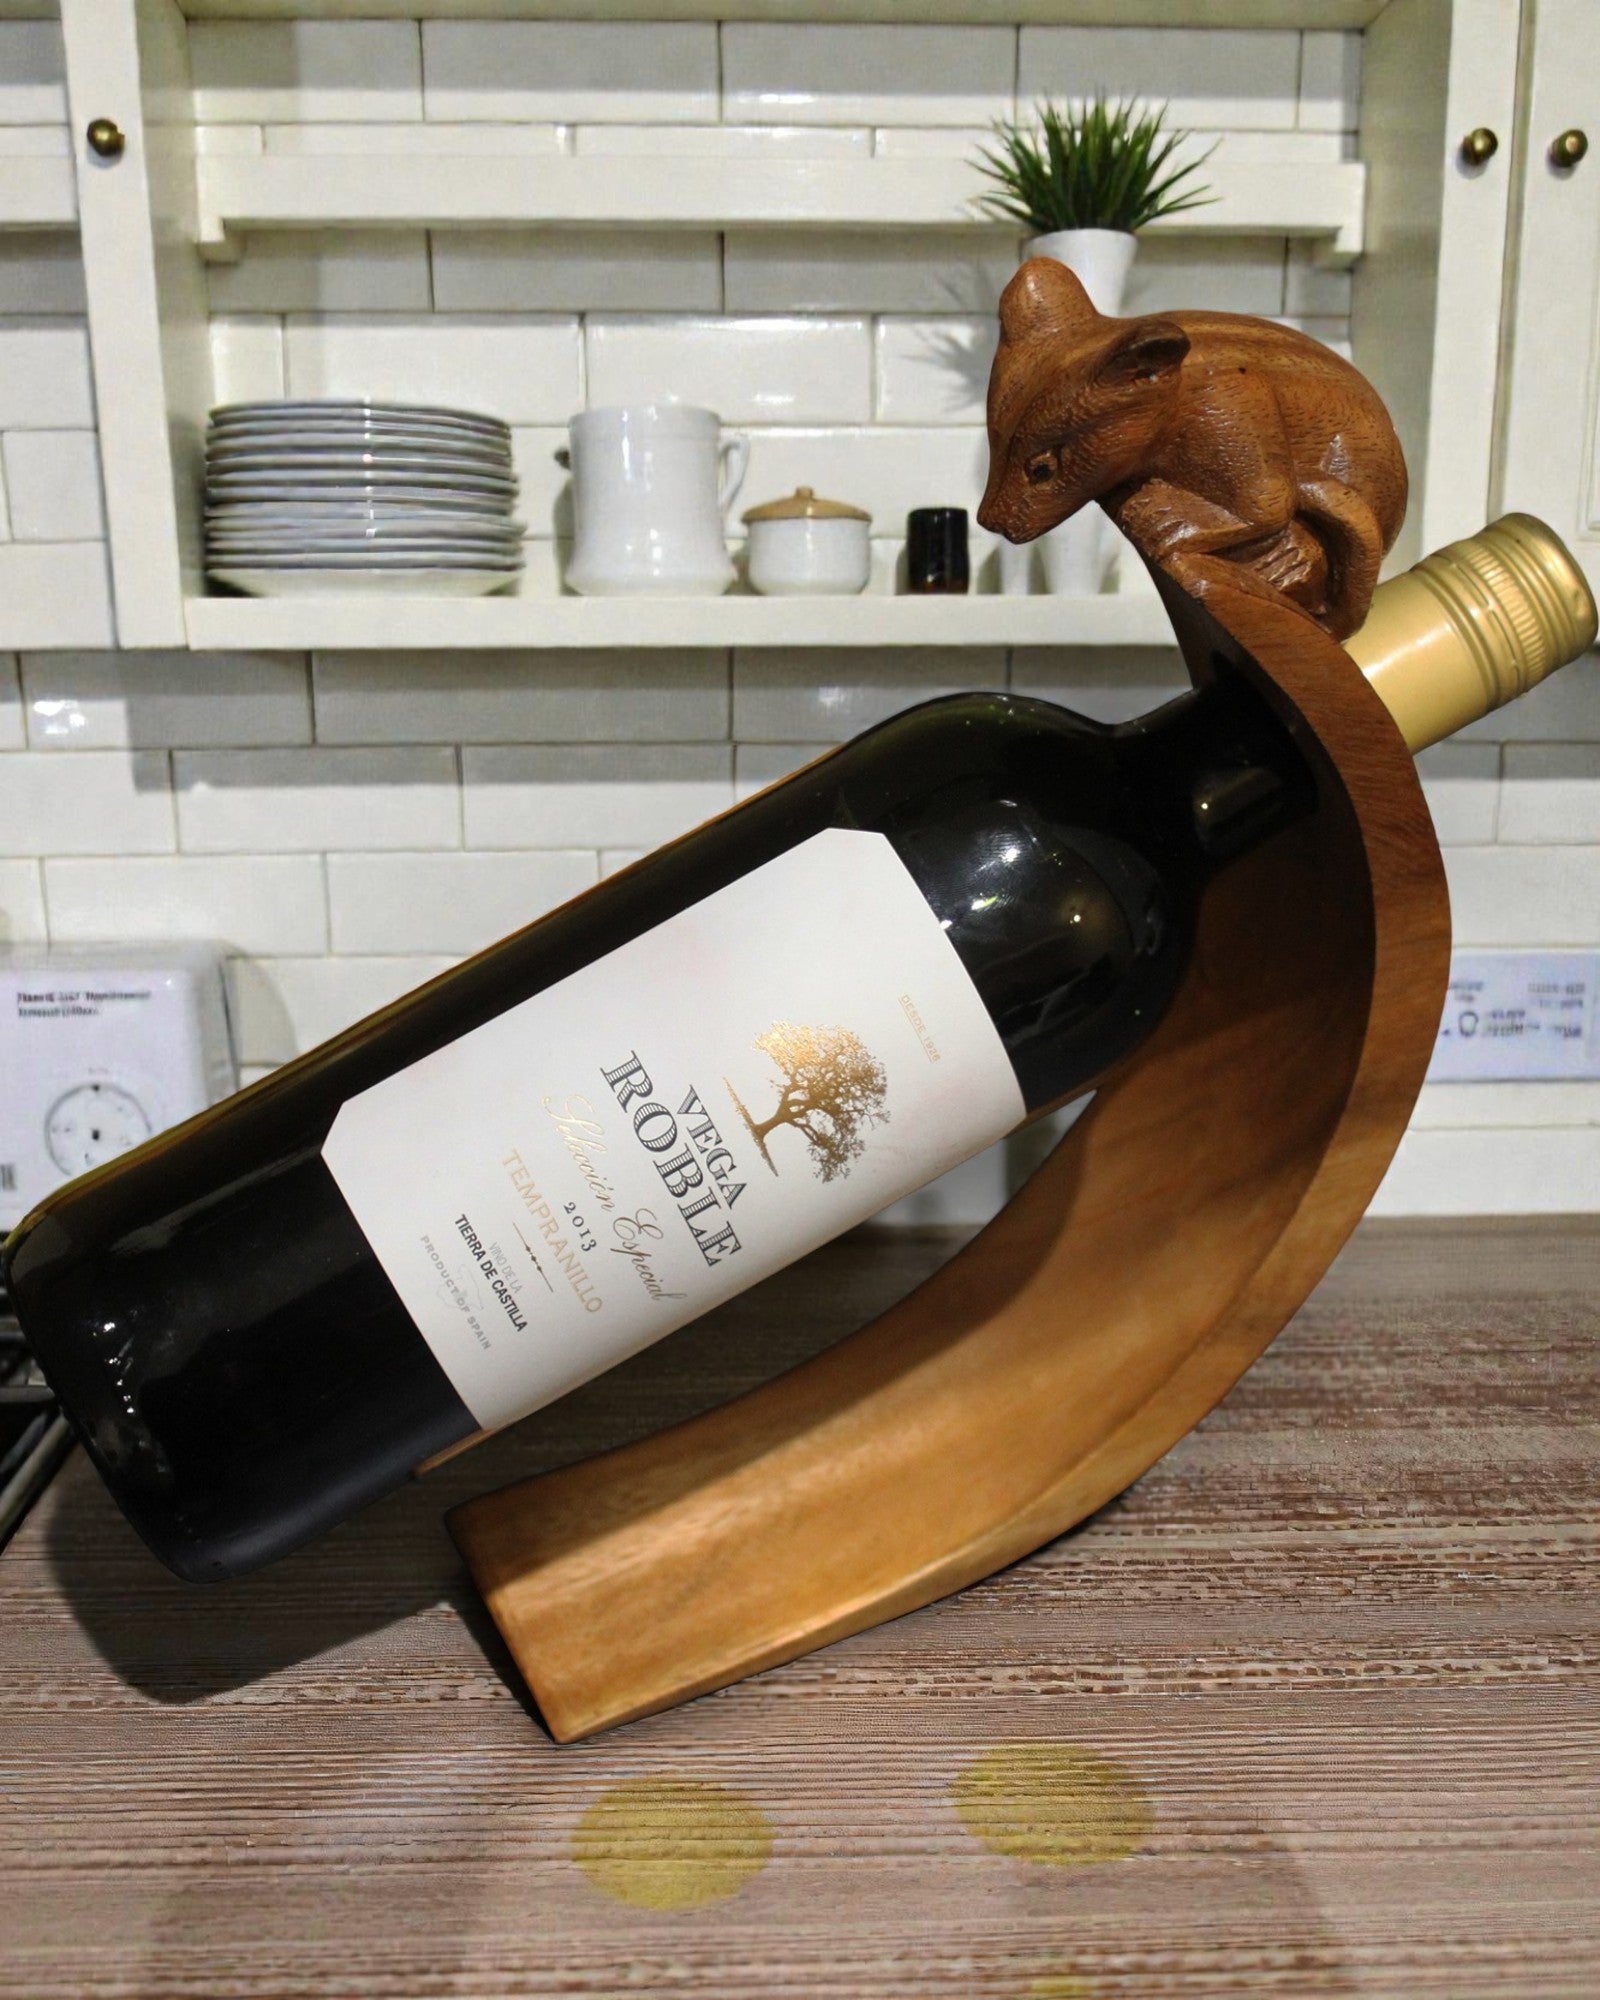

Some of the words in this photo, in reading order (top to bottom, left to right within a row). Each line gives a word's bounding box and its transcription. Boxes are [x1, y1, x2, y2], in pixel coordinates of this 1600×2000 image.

[901, 994, 927, 1033] DESDE
[541, 1094, 616, 1212] Selección
[610, 1208, 688, 1301] Especial
[600, 1050, 742, 1267] ROBLE
[677, 1084, 747, 1209] VEGA
[455, 1214, 486, 1261] TIERRA
[480, 1260, 498, 1280] DE
[491, 1279, 528, 1332] CASTILLA
[489, 1242, 507, 1264] VINO
[503, 1265, 516, 1281] DE
[510, 1279, 523, 1294] LA
[502, 1147, 603, 1313] TEMPRANILLO
[563, 1201, 597, 1252] 2013
[420, 1235, 459, 1295] PRODUCT
[456, 1298, 471, 1314] OF
[467, 1316, 491, 1350] SPAIN
